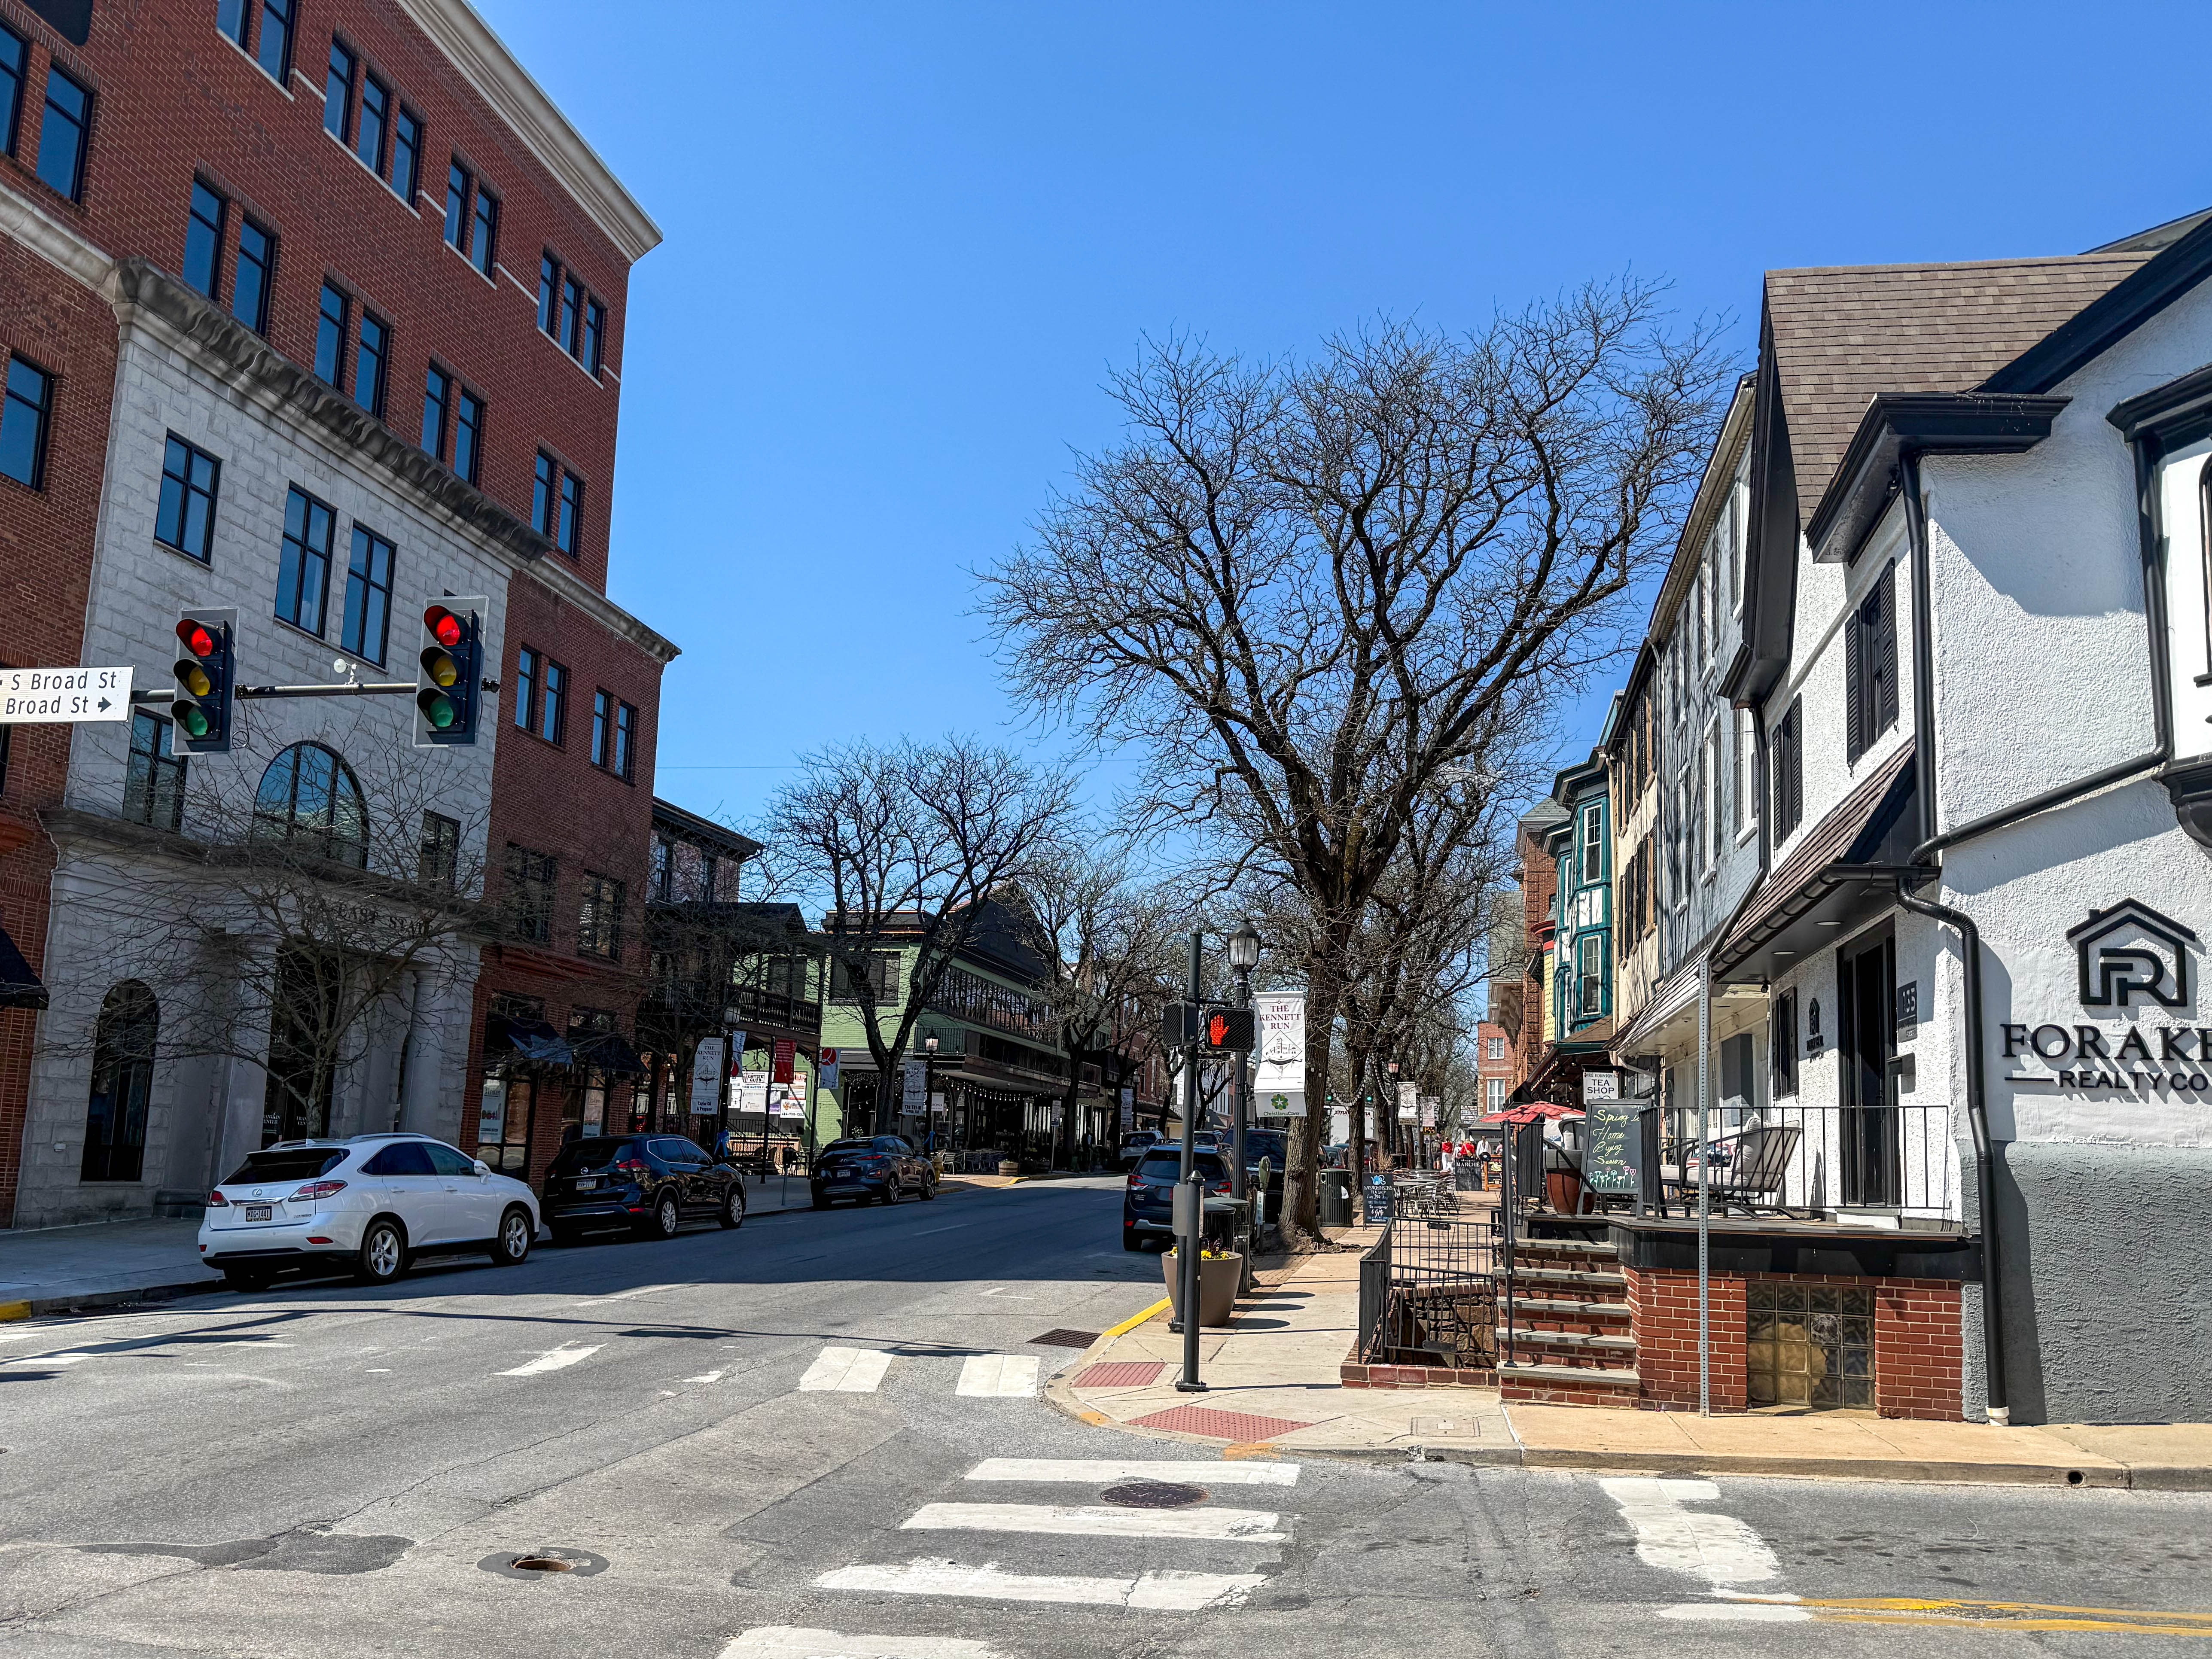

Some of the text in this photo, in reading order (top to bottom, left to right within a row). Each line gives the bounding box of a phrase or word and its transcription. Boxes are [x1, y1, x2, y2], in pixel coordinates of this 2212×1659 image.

[11, 671, 117, 691] S Broad St
[6, 696, 88, 715] Broad St
[1593, 1109, 1629, 1127] Spring
[1593, 1126, 1625, 1141] Home
[1593, 1141, 1624, 1157] Buying
[1593, 1156, 1626, 1165] Season
